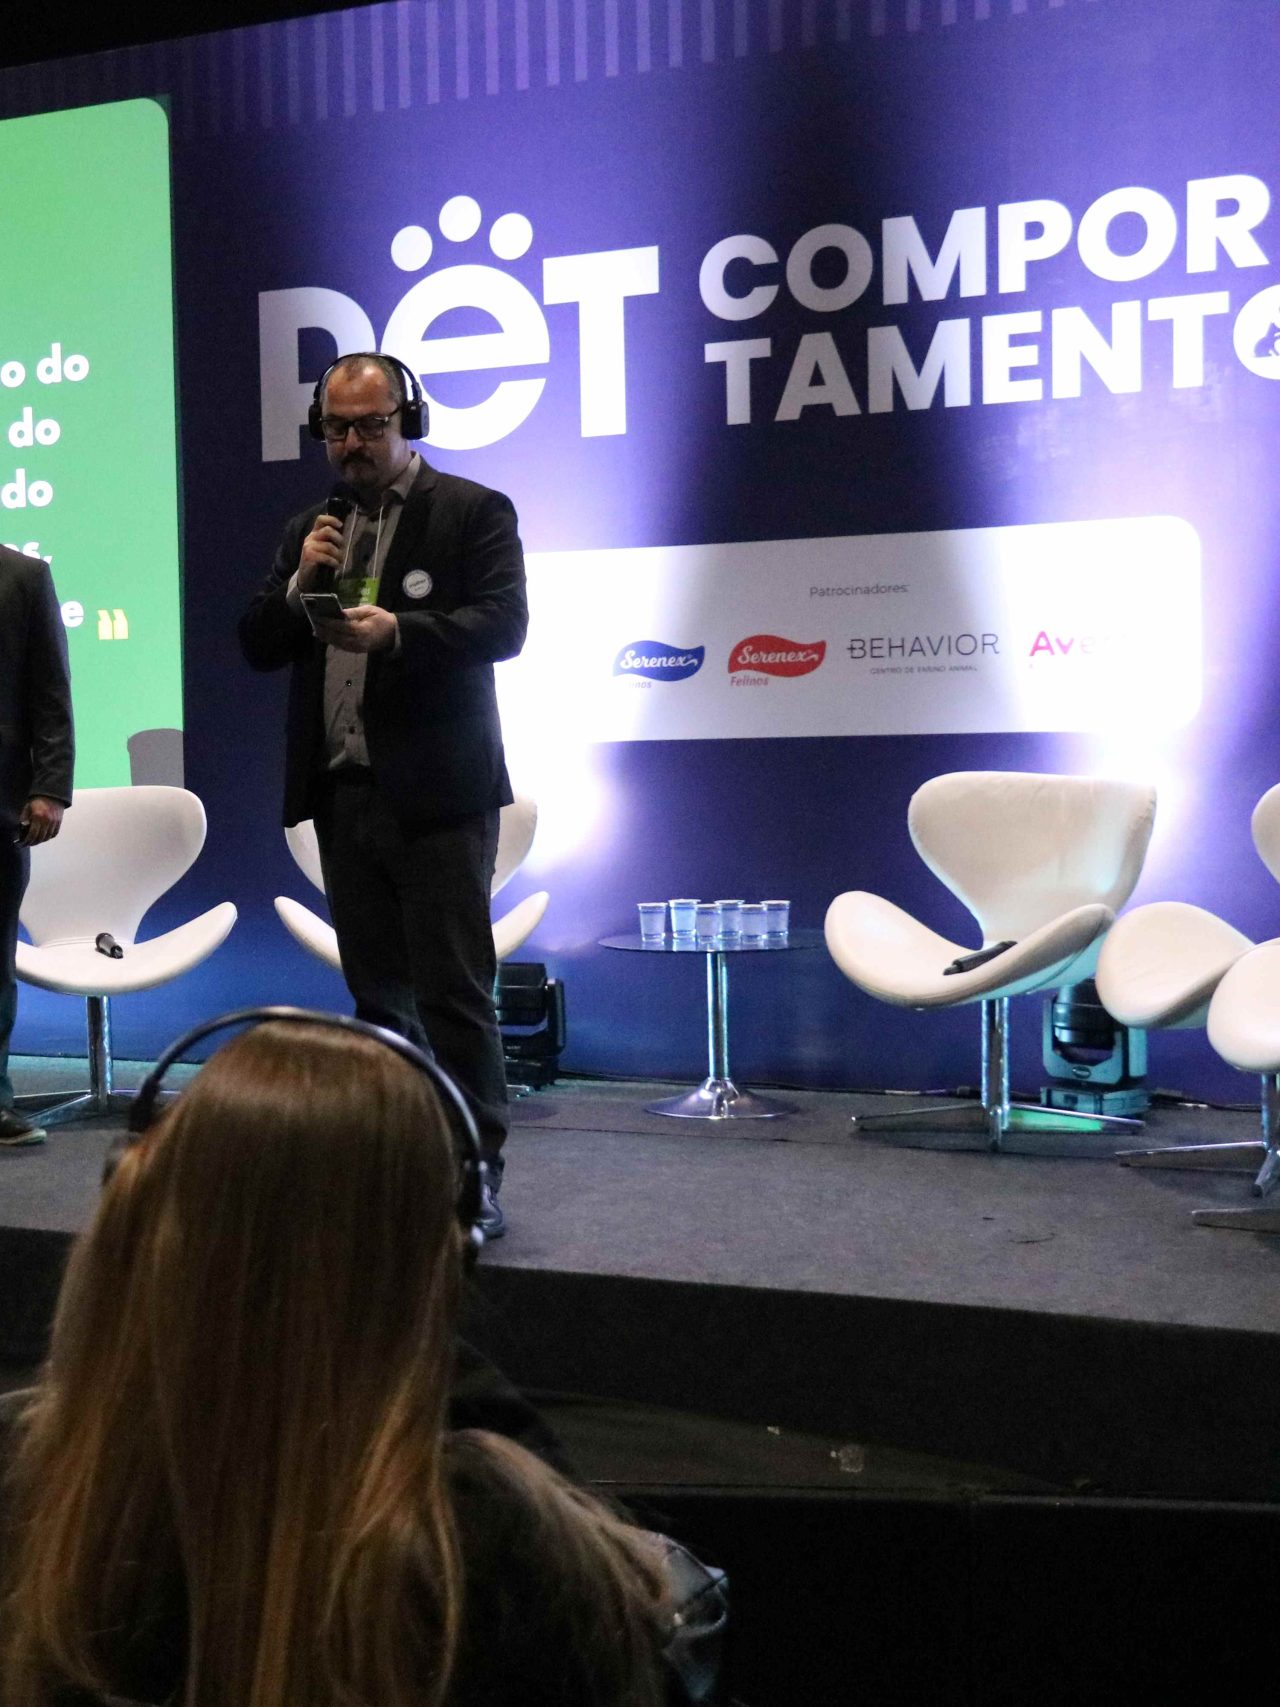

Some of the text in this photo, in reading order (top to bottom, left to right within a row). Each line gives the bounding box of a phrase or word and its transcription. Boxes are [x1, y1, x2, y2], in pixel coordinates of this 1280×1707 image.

[698, 174, 1271, 320] COMPOR
[36, 342, 90, 385] do
[7, 406, 61, 448] do
[621, 649, 698, 670] Serenex
[737, 645, 819, 665] Serenex
[847, 633, 1000, 660] BEHAVIOR
